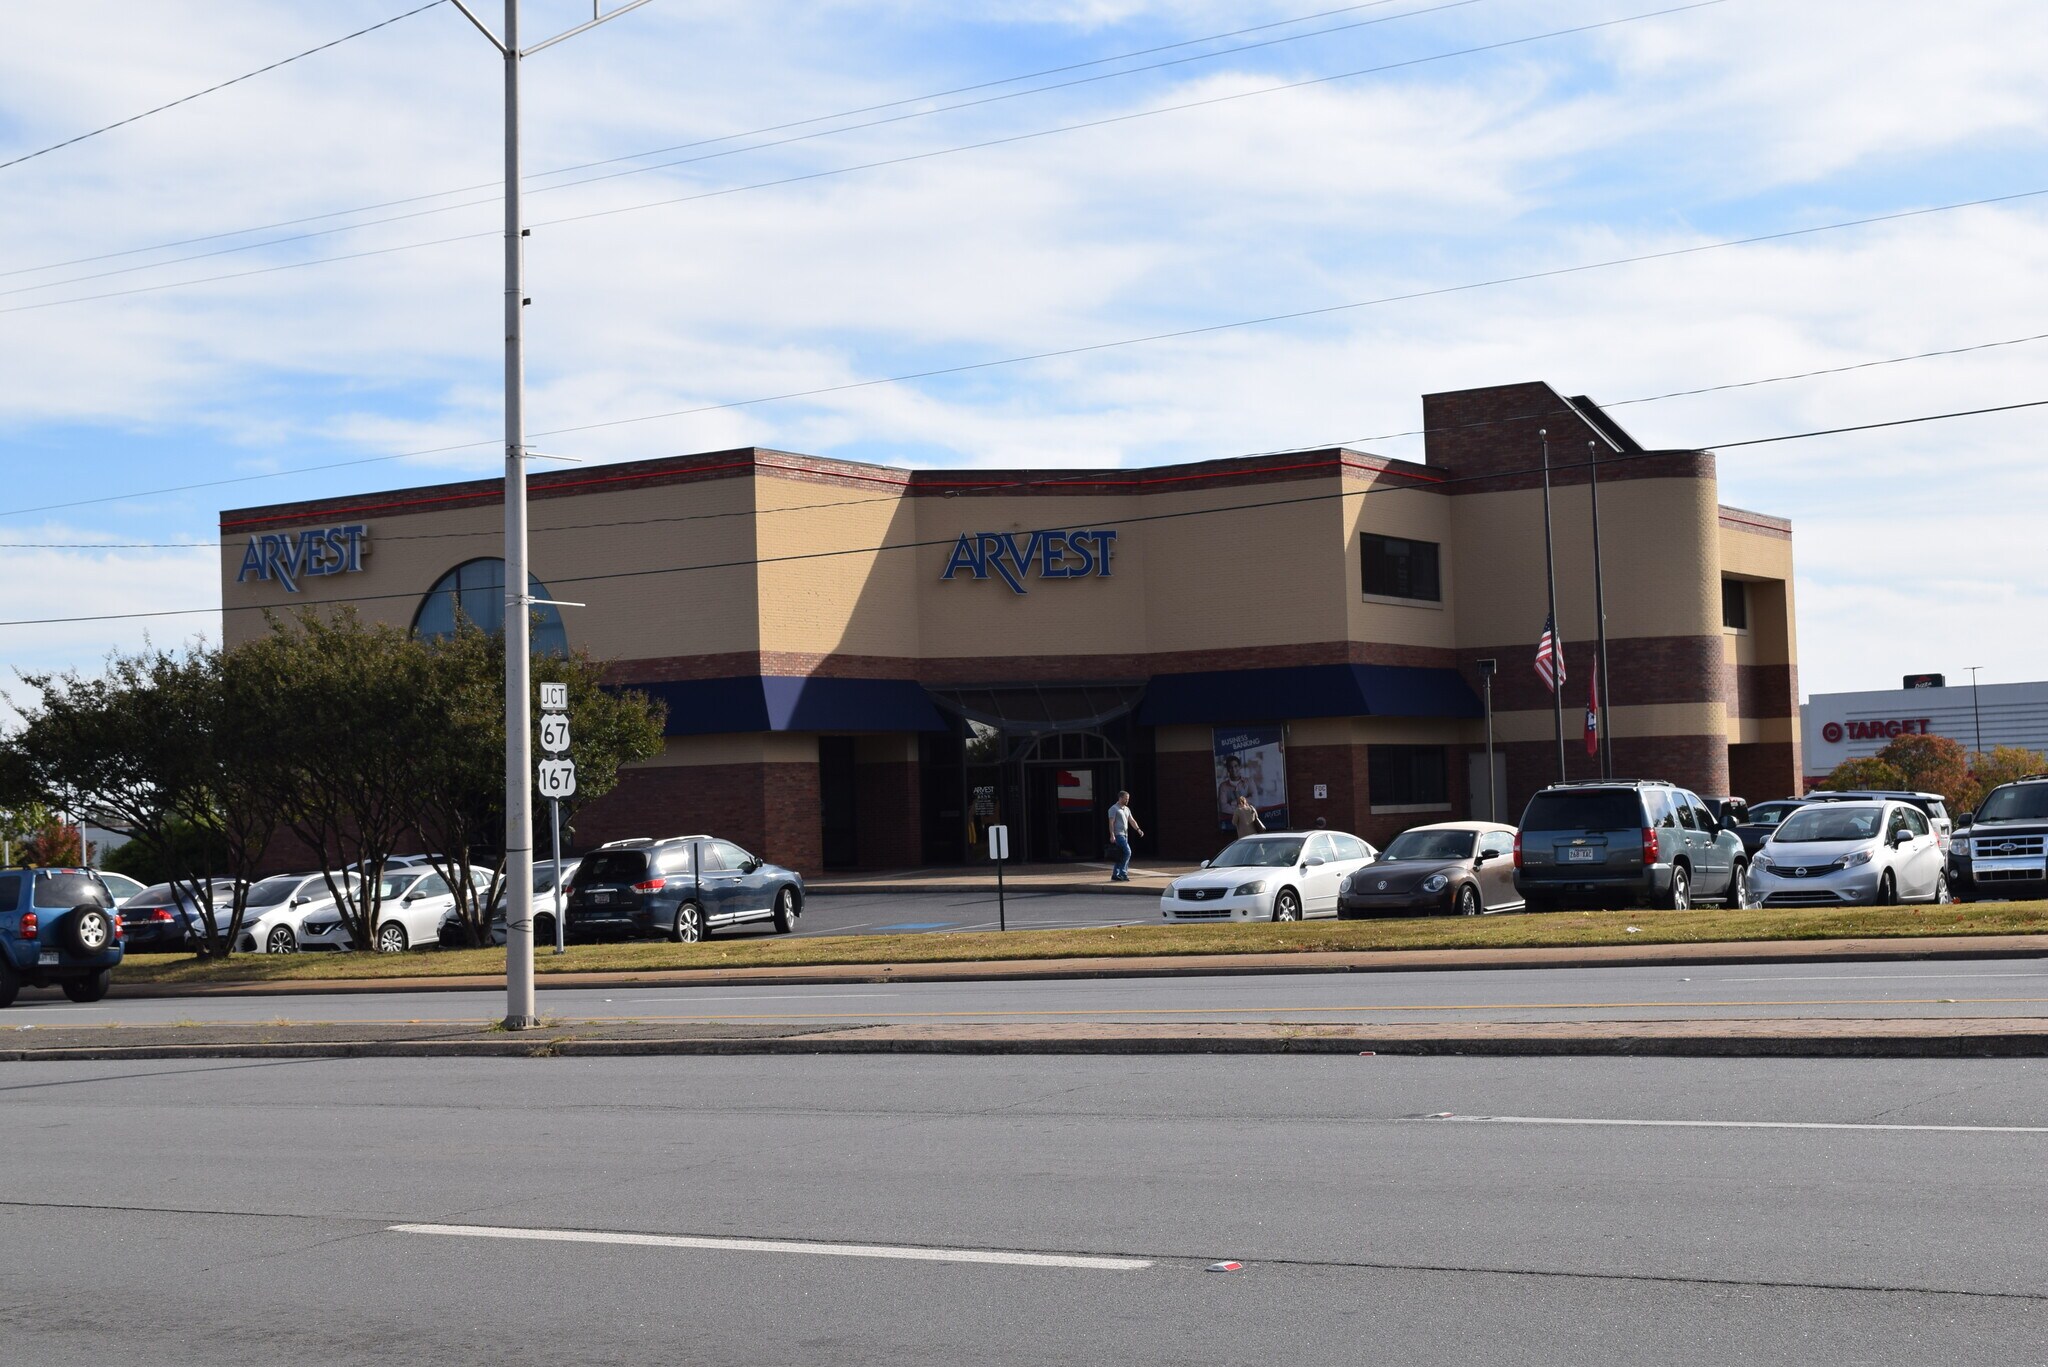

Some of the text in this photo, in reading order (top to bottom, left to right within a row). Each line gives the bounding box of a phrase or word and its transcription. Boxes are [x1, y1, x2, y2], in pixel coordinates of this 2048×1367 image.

[236, 524, 368, 593] ARVEST
[940, 529, 1118, 595] ARVEST
[543, 688, 564, 705] JCT
[544, 723, 566, 744] 67
[1844, 718, 1930, 740] TARGET
[1221, 734, 1248, 746] BUSINESS
[1232, 738, 1260, 750] BANKING
[541, 768, 572, 790] 167
[973, 786, 994, 795] ARVEST
